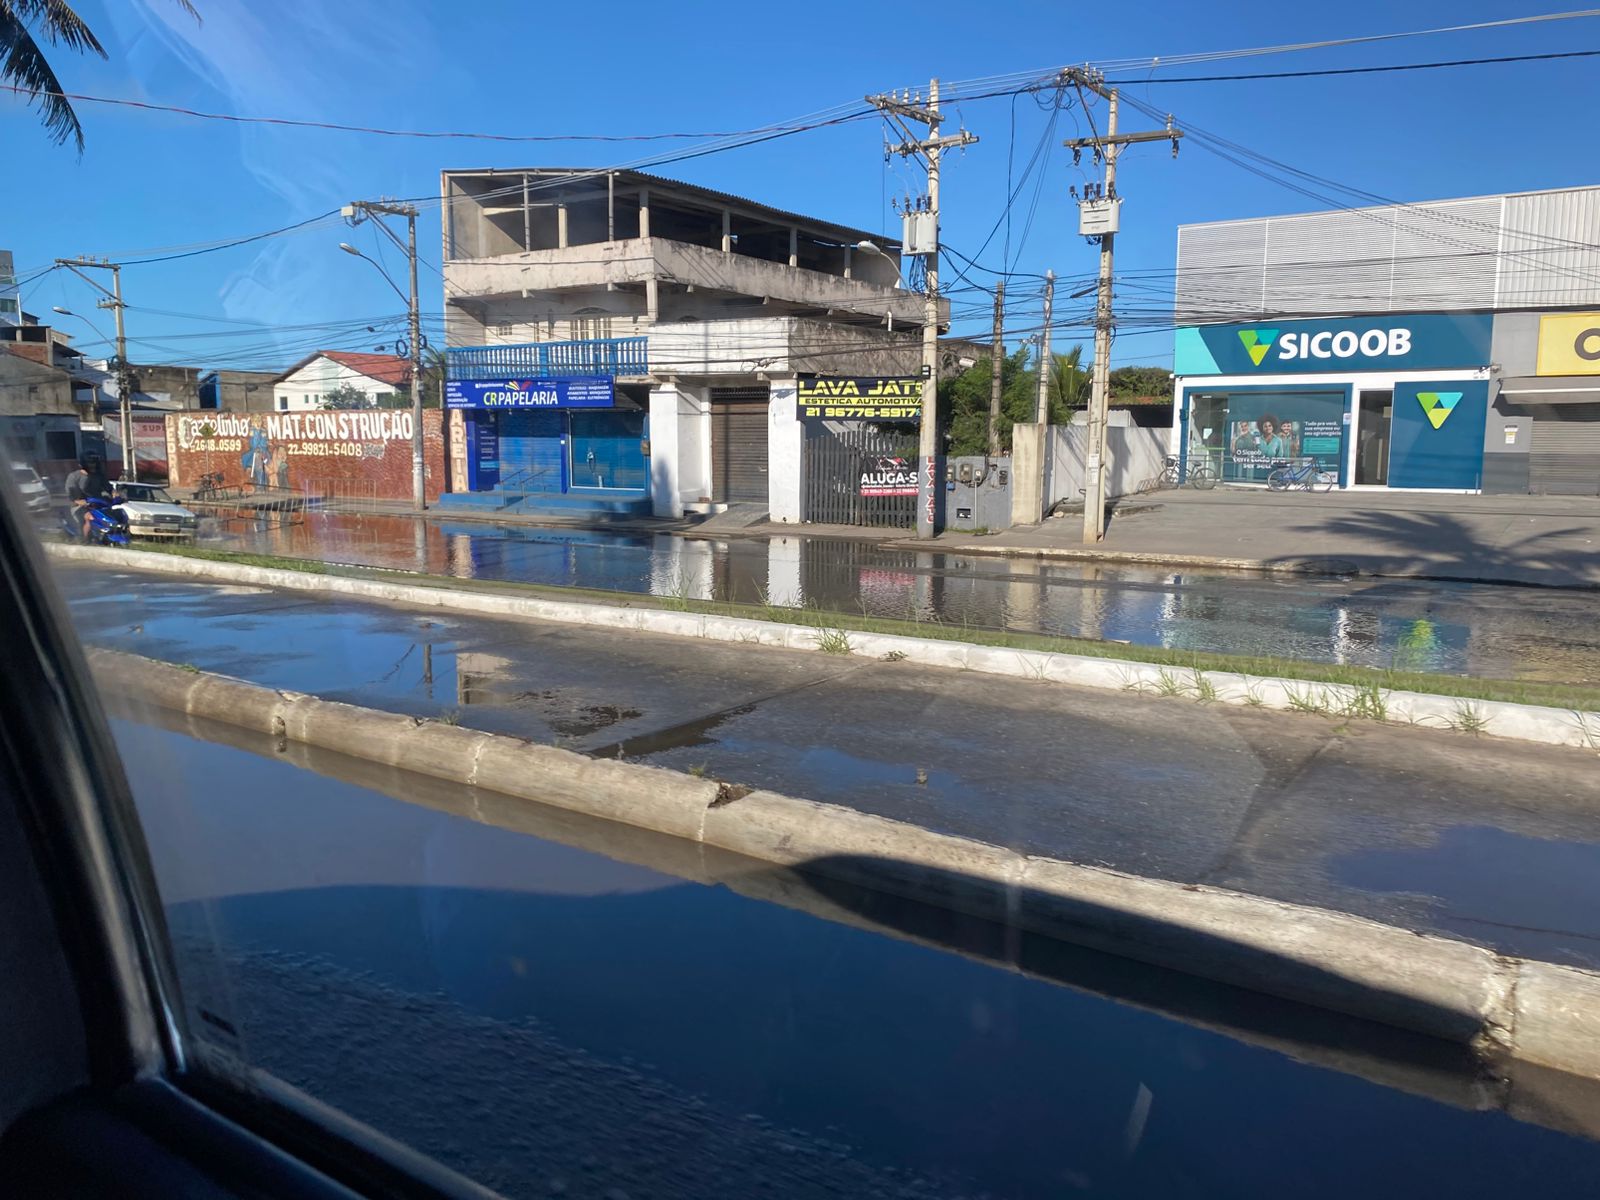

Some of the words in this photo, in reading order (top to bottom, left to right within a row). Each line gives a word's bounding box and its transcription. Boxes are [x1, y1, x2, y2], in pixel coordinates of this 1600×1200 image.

[1278, 328, 1411, 359] SICOOB
[799, 380, 859, 395] LAVA
[806, 407, 820, 416] 21
[861, 472, 919, 484] ALUGA-S
